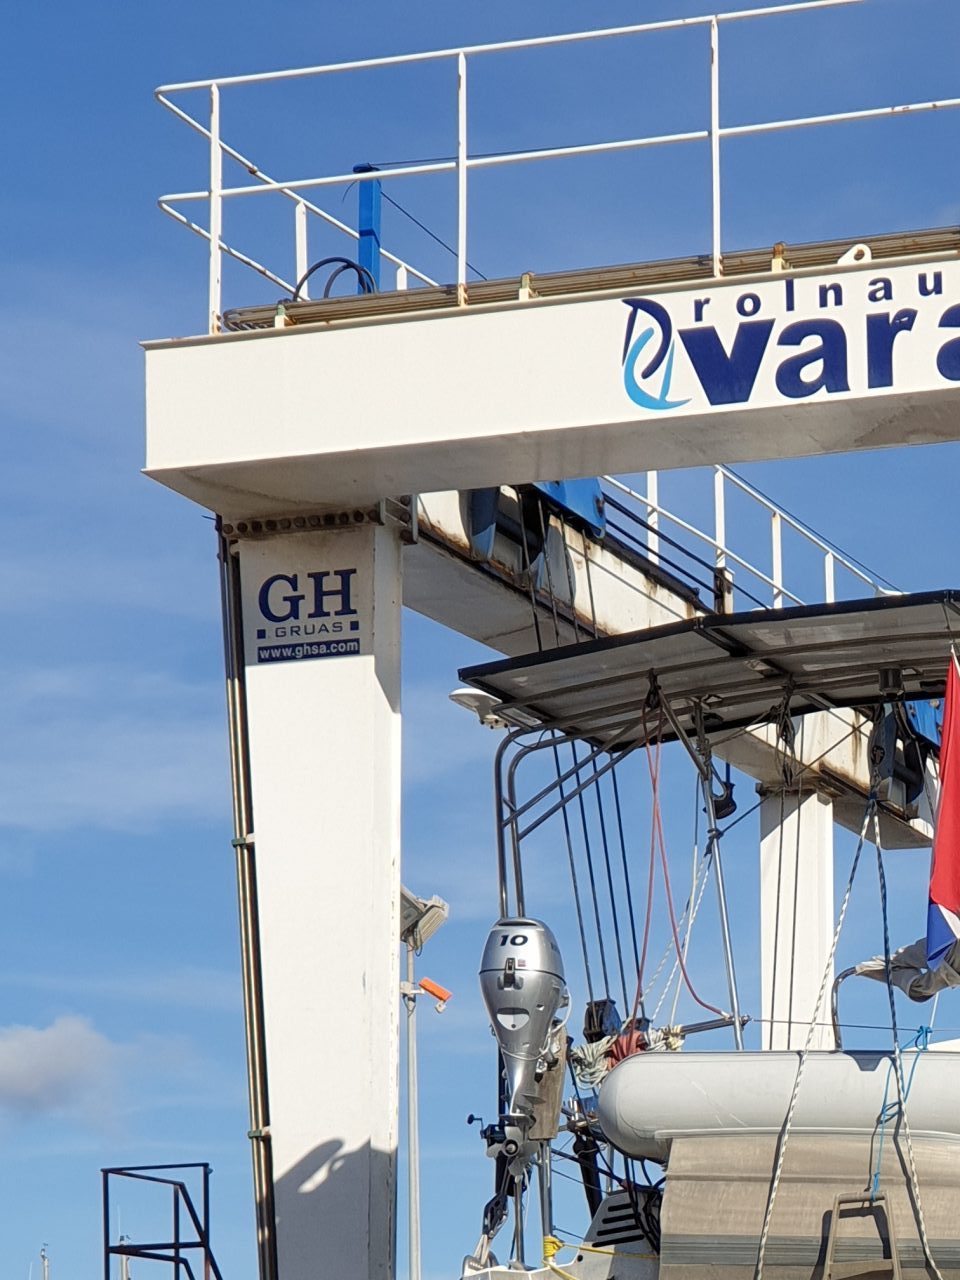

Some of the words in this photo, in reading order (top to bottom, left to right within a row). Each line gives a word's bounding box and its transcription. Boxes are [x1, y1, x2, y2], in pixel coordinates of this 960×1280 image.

[258, 568, 358, 623] GH
[275, 621, 343, 638] GRUAS
[259, 641, 358, 659] www.ghsa.com
[500, 934, 529, 947] 10
